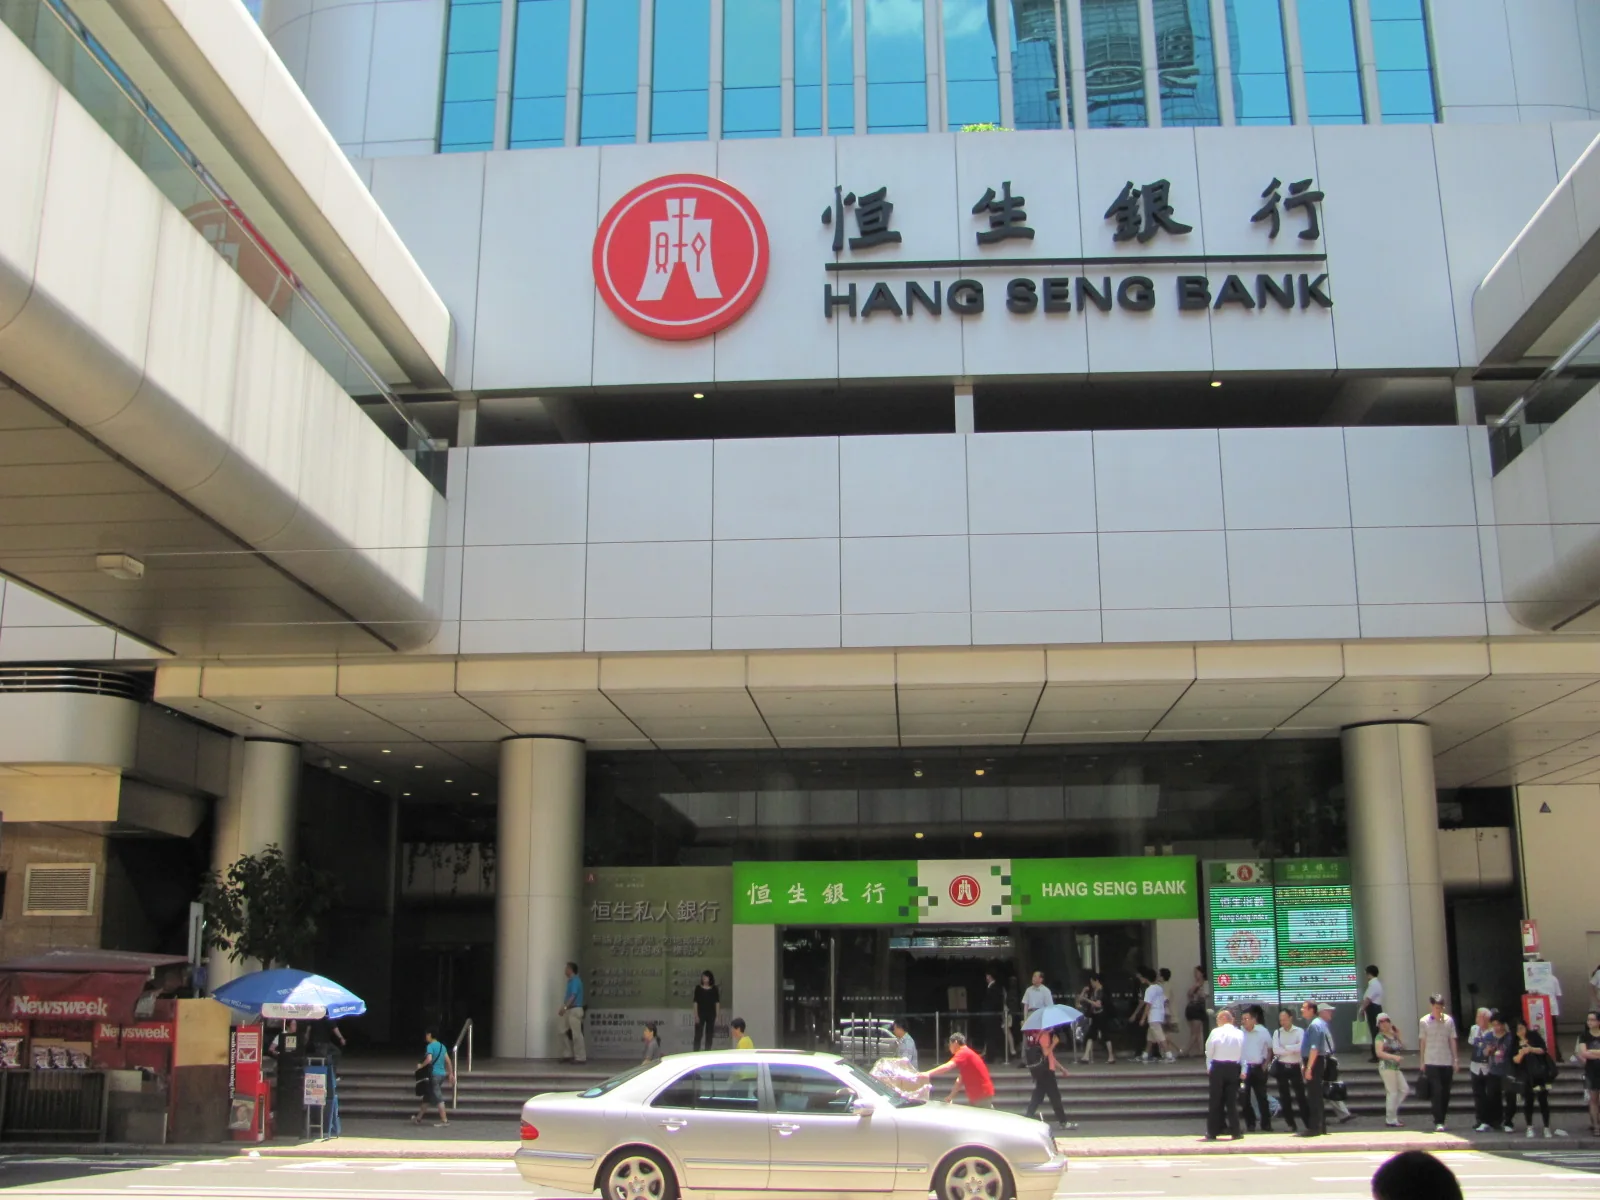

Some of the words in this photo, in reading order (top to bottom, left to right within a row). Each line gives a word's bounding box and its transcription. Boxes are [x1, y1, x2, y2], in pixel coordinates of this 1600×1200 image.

[822, 178, 1325, 251] 恒生銀行
[824, 277, 985, 318] HANG
[1006, 275, 1155, 314] SENG
[1177, 272, 1334, 311] BANK
[746, 882, 887, 907] 恒生銀行
[1041, 882, 1088, 897] HANG
[1092, 881, 1138, 896] SENG
[1142, 880, 1187, 895] BANK
[591, 899, 721, 922] 恒生私人銀行
[12, 995, 108, 1016] Newsweek
